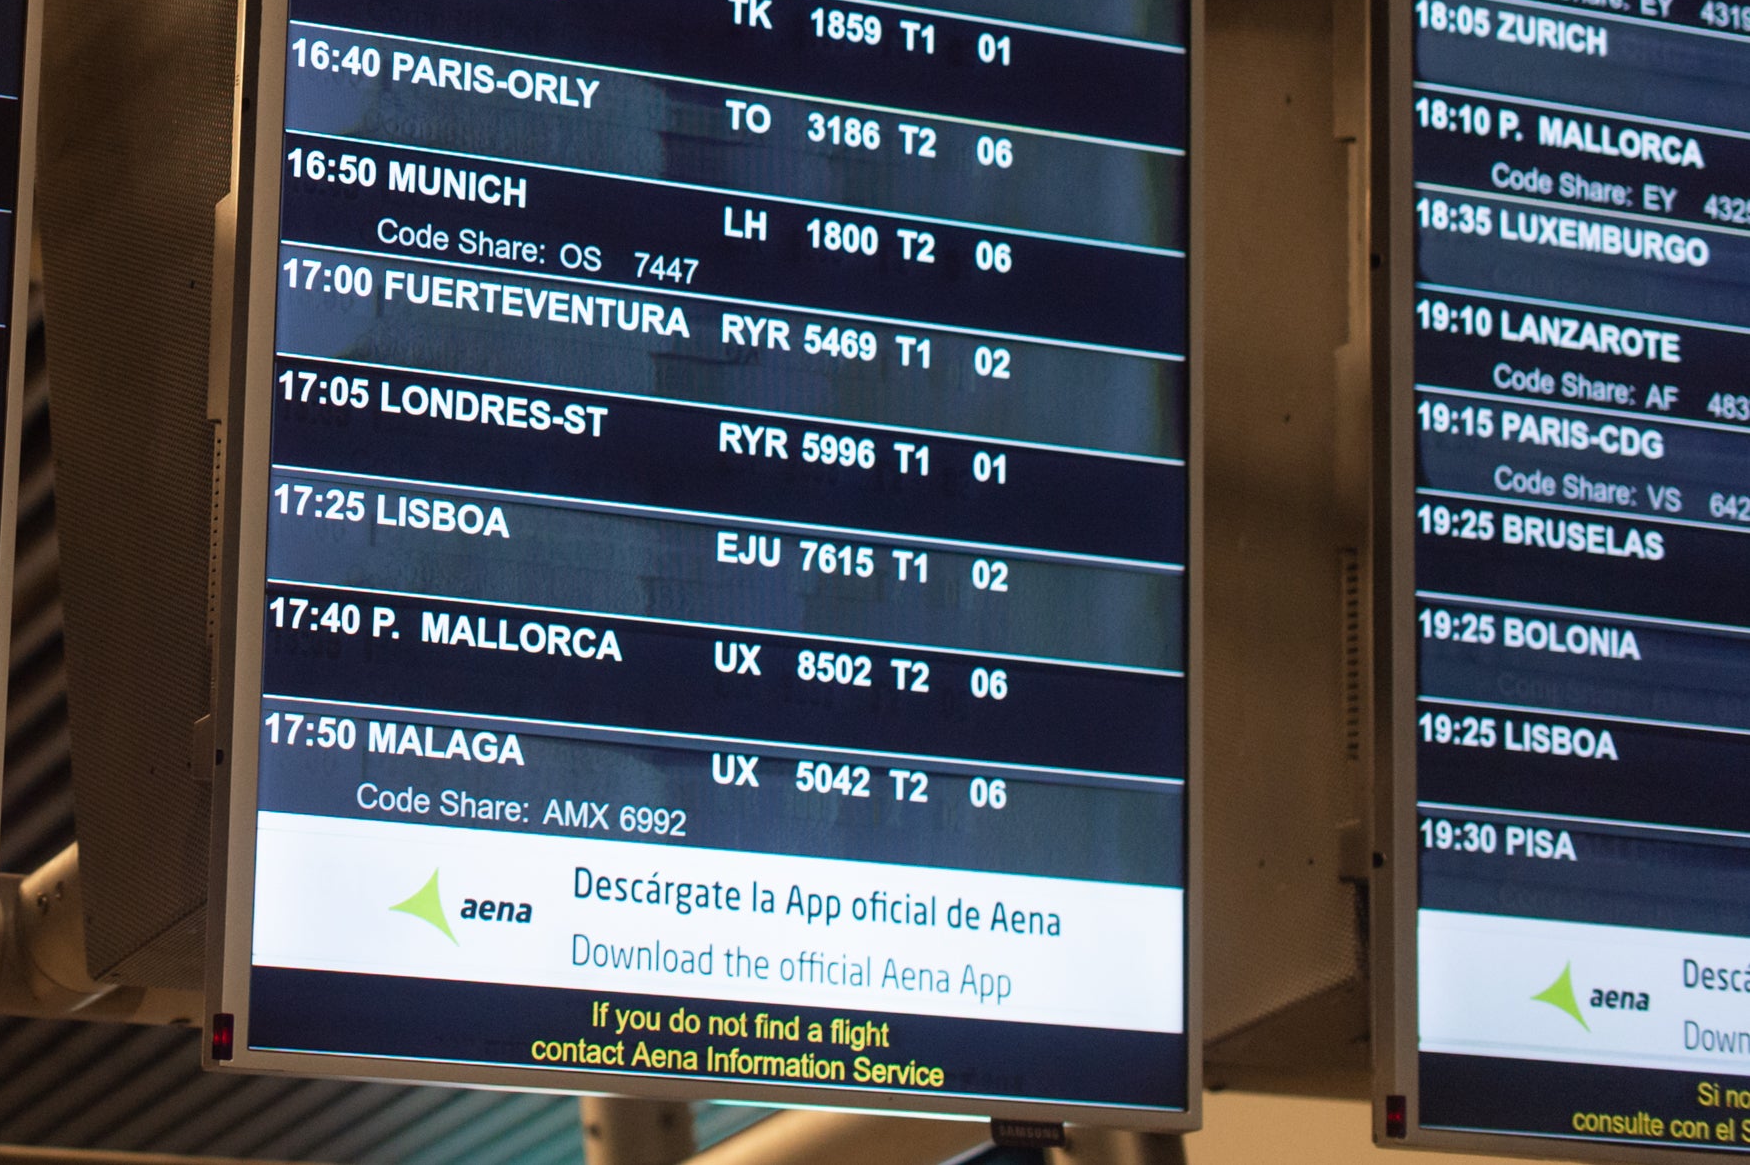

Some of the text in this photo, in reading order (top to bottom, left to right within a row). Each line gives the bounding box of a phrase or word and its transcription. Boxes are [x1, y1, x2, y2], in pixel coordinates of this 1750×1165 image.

[1496, 10, 1608, 57] ZURICH
[291, 37, 1014, 169] 16:40 PARIS-ORLY TO 3186 T2 06
[1416, 197, 1710, 267] 18:35 LUXEMBURGO
[283, 257, 1011, 380] 17:00 FUERTEVENTURA RYR 5469 T1 02
[1416, 299, 1681, 363] 19:10 LANZAROTE
[269, 596, 1008, 701] 17:40 P. MALLORCA UX 8502 T2 06
[1419, 608, 1642, 661] 19:25 BOLONIA
[1420, 818, 1578, 862] 19:30 PISA
[460, 898, 533, 924] aena
[592, 1000, 890, 1052] If you do not find a flight
[1589, 988, 1650, 1012] aena
[1572, 1111, 1735, 1142] consulte con el
